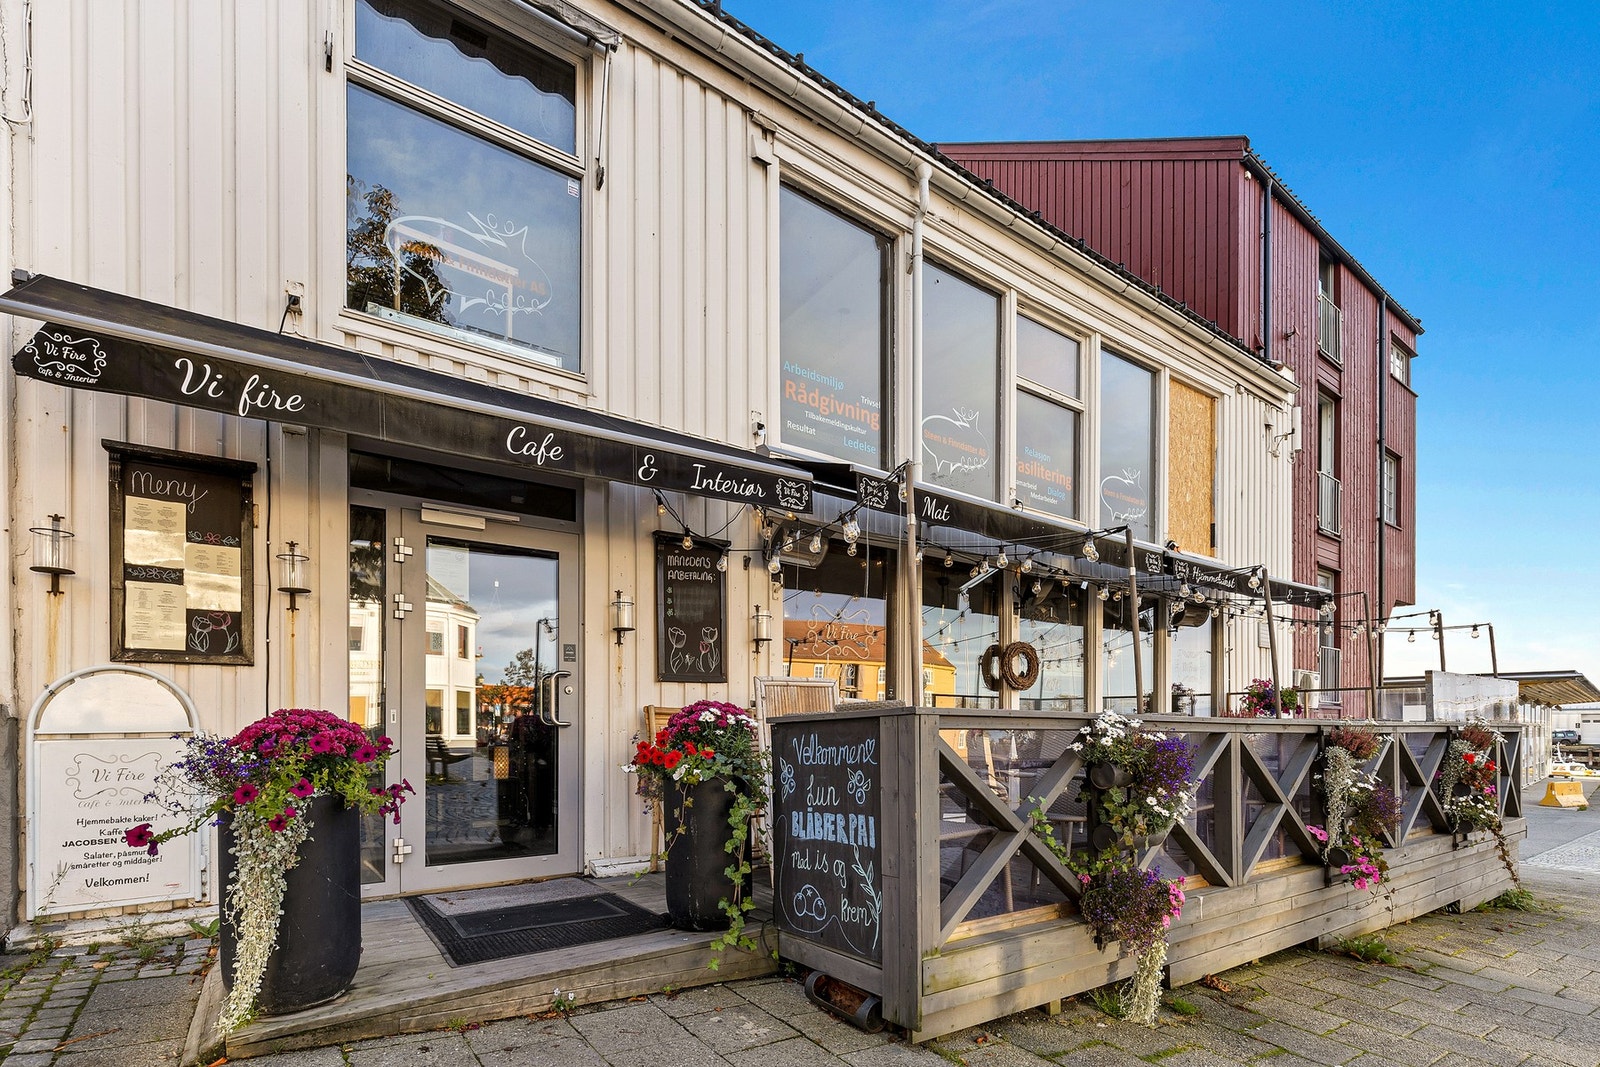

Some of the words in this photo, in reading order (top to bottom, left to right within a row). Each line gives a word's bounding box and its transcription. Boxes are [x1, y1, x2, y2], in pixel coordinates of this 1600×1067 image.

[43, 341, 59, 356] Vi
[62, 346, 87, 361] Fire
[783, 360, 844, 390] Arbeidsmiljø
[175, 357, 224, 398] Vi
[238, 374, 306, 416] fire
[785, 379, 880, 432] Rådgivning
[861, 395, 880, 409] Trivsel
[786, 420, 816, 436] Resultat
[804, 410, 867, 435] Tilbakemeldingskultur
[843, 435, 876, 454] Ledelse
[1024, 446, 1051, 462] Relasjon
[506, 426, 564, 465] Cafe
[638, 454, 658, 481] &
[690, 463, 766, 498] Interiør
[1016, 458, 1072, 491] asilitering
[131, 471, 208, 513] Meny
[1047, 486, 1066, 501] Dialog
[922, 496, 950, 521] Mat
[793, 733, 871, 766] Velkommen
[91, 768, 111, 783] Vi
[117, 767, 145, 782] Fire
[807, 774, 840, 806] Lun
[76, 815, 132, 827] Hjemmebakte
[133, 814, 158, 822] kaker!
[62, 838, 117, 847] JACOBSEN
[70, 860, 109, 870] småretter
[112, 860, 122, 868] og
[124, 855, 163, 866] middager!
[83, 852, 116, 861] Salater,
[117, 850, 147, 860] påsmur
[814, 849, 828, 873] is
[833, 860, 846, 888] og
[85, 873, 150, 888] Velkommen!
